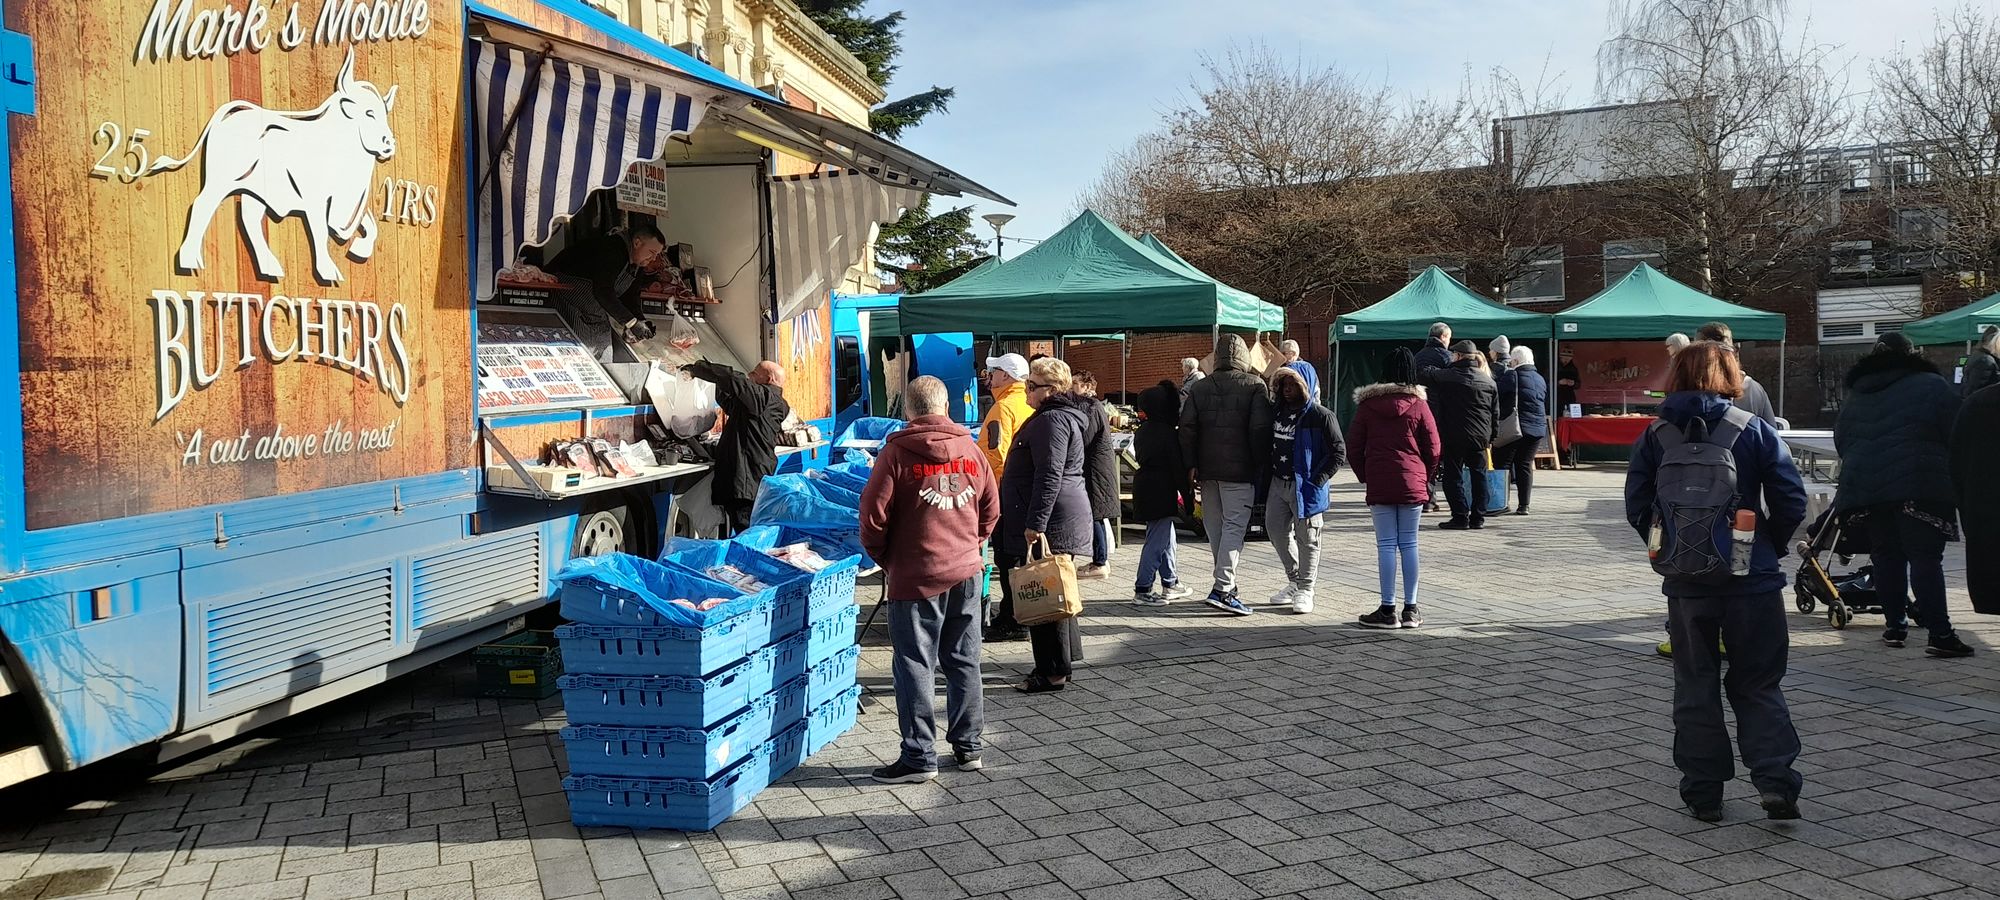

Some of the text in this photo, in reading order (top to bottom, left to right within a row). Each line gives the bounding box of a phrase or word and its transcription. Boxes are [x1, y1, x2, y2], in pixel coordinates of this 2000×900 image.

[136, 0, 430, 62] Mark's Mobile
[91, 121, 151, 181] 25
[380, 176, 438, 225] YRS
[149, 288, 411, 422] BUTCHERS
[502, 378, 517, 389] OR
[517, 377, 535, 388] FOR
[510, 388, 549, 405] £50.00
[210, 428, 251, 464] cut
[254, 423, 318, 462] above
[322, 419, 354, 455] the
[912, 459, 960, 480] SUPER
[938, 473, 960, 493] 65
[918, 485, 977, 511] JAPAN ATH
[1017, 586, 1049, 600] Welsh
[1020, 580, 1042, 590] really
